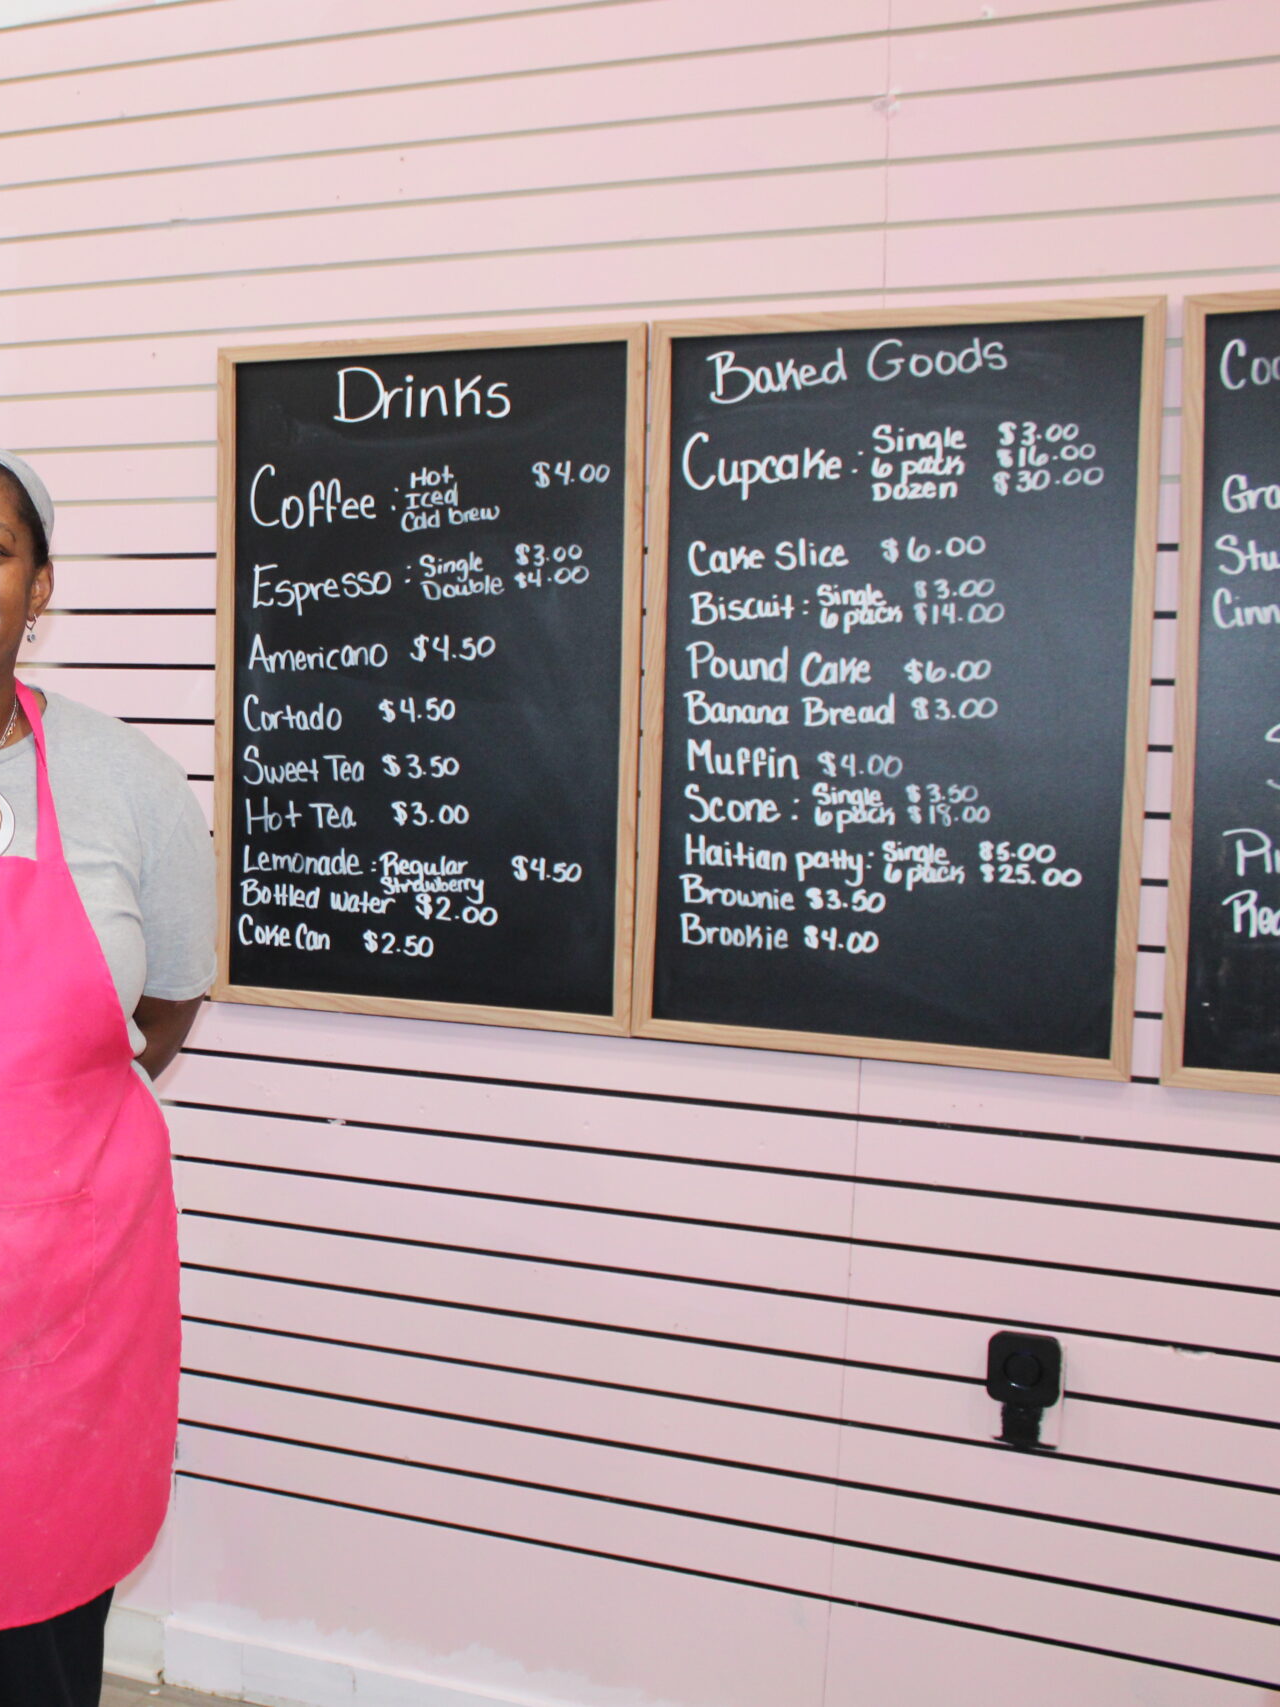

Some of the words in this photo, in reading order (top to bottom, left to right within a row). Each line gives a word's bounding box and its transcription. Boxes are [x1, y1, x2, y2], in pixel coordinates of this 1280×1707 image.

[707, 348, 847, 405] Baked
[867, 337, 1008, 382] Goods
[333, 366, 511, 422] Drinks
[872, 425, 967, 457] Single
[998, 421, 1079, 446] $3.00
[410, 465, 454, 487] Hot
[531, 460, 610, 488] $4.00
[900, 455, 965, 483] pack
[996, 443, 1096, 469] $16.00
[405, 483, 459, 510] Iced
[872, 481, 958, 501] Dozen
[992, 466, 1104, 495] $30.00
[401, 508, 440, 533] Cold
[448, 504, 500, 525] brew
[419, 551, 484, 583] Single
[515, 543, 583, 566] $3.00
[688, 540, 766, 576] Cake
[775, 538, 849, 570] Slice
[880, 535, 987, 564] $6.00
[421, 575, 505, 601] Double
[514, 565, 590, 589] $4.00
[817, 584, 886, 608] Single
[914, 579, 995, 599] $3.00
[844, 604, 903, 634] pack
[914, 602, 1005, 625] $14.00
[248, 633, 388, 673] Americano
[410, 634, 496, 662] $4.50
[685, 641, 789, 683] Pound
[801, 651, 872, 687] Cake
[903, 659, 992, 684] $6.00
[243, 695, 343, 732] Cortado
[378, 697, 456, 723] $4.50
[684, 690, 789, 726] Banana
[802, 692, 896, 726] Bread
[911, 697, 998, 720] $3.00
[243, 745, 320, 786] Sweet
[323, 754, 365, 783] Tea
[381, 754, 460, 779] $3.50
[687, 739, 800, 780] Muffin
[817, 751, 903, 778] $4.00
[812, 782, 884, 810] Single
[906, 784, 978, 803] $3.50
[245, 796, 302, 835] Hot
[308, 803, 357, 829] Tea
[391, 801, 470, 827] $3.00
[836, 805, 896, 833] pack
[907, 805, 991, 826] $18.00
[379, 851, 469, 881] Regular
[511, 855, 582, 883] $4.50
[684, 833, 787, 872] Haitian
[881, 841, 948, 870] Single
[979, 841, 1056, 863] $5.00
[380, 875, 485, 904] Strawberry
[679, 873, 796, 912] Brownie
[805, 887, 887, 914] $3.50
[906, 864, 965, 891] pack
[980, 863, 1082, 888] $25.00
[240, 879, 320, 910] Bottled
[415, 894, 499, 926] $2.00
[238, 914, 292, 948] Coke
[294, 918, 331, 951] Can
[363, 929, 434, 958] $2.50
[679, 913, 789, 950] Brookie
[803, 925, 879, 954] $4.00
